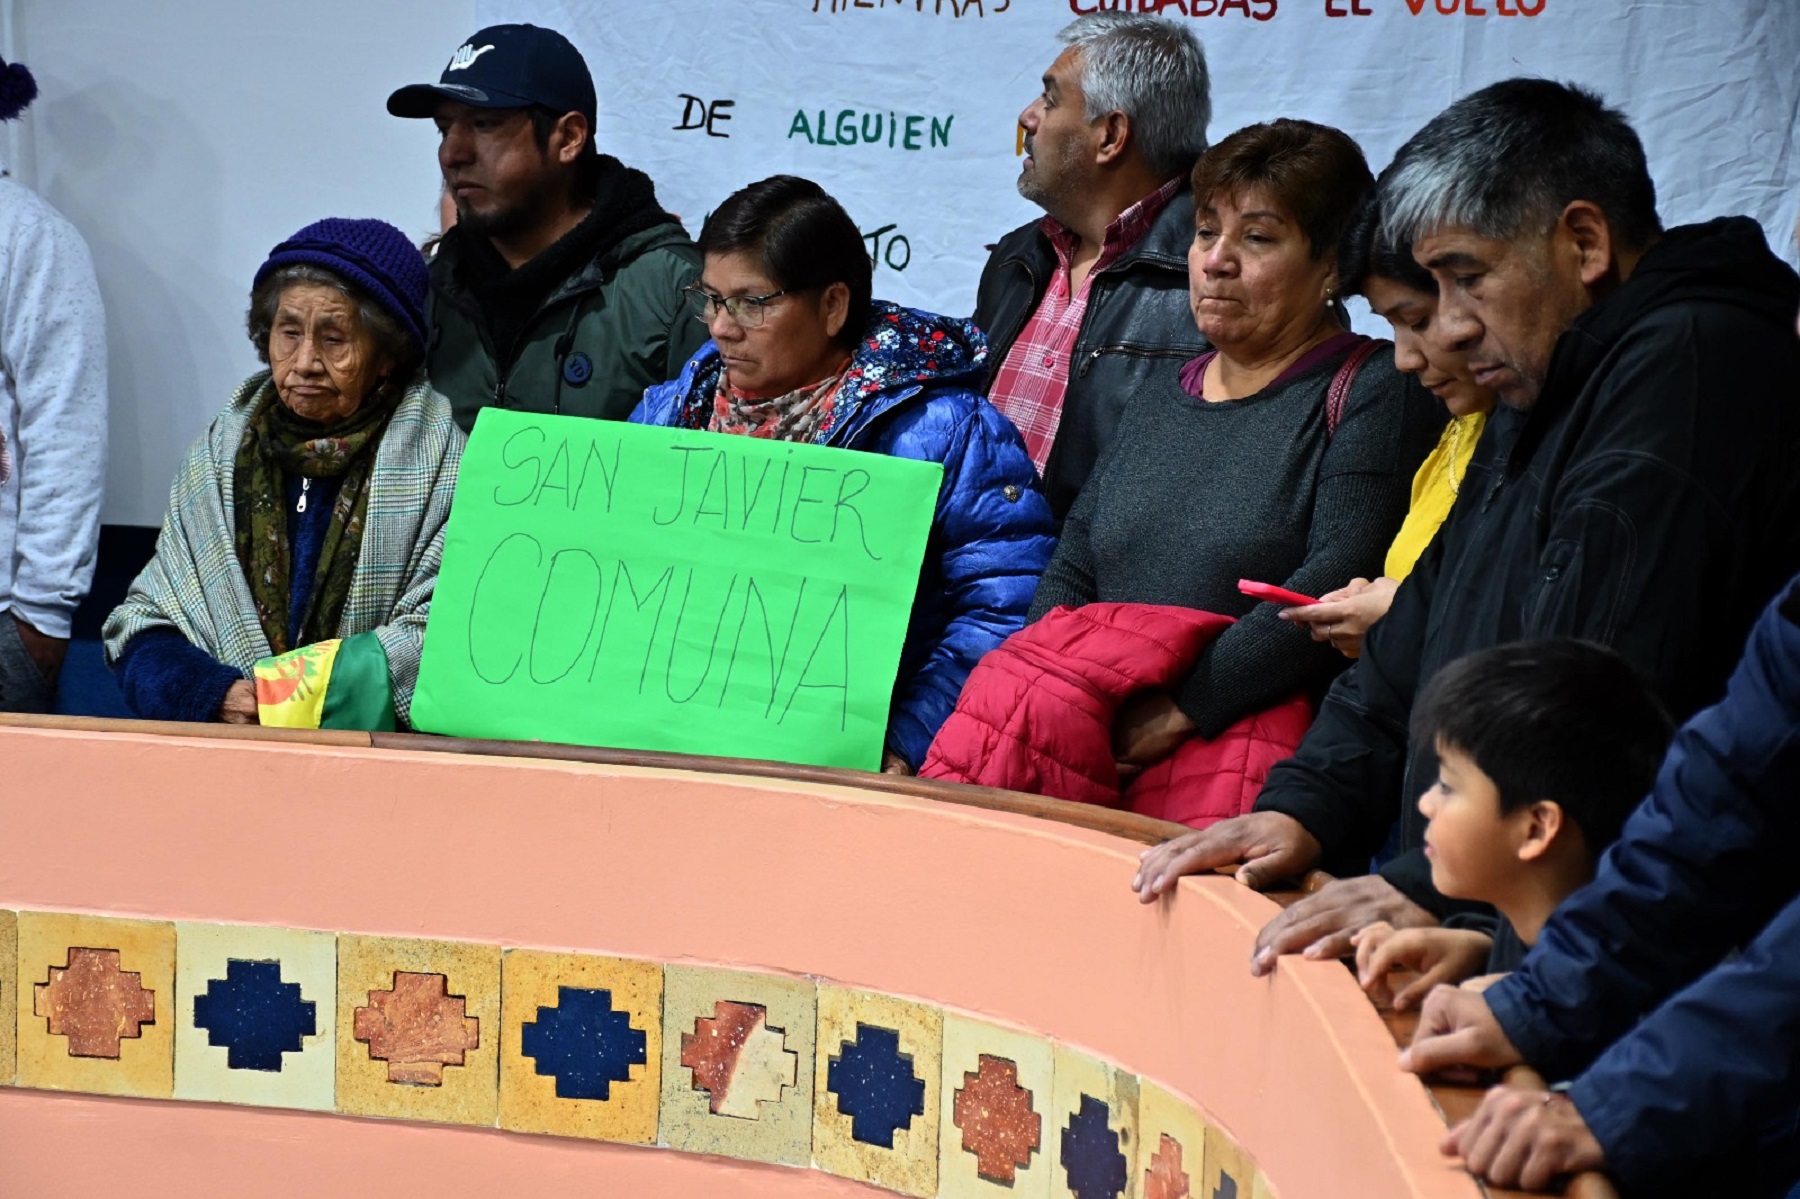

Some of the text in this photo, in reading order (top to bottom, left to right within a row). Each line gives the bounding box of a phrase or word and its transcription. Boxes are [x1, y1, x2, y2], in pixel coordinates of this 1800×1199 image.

[672, 93, 735, 138] DE
[858, 223, 910, 271] TO
[494, 426, 621, 512] SAN
[468, 533, 847, 732] COMUNA
